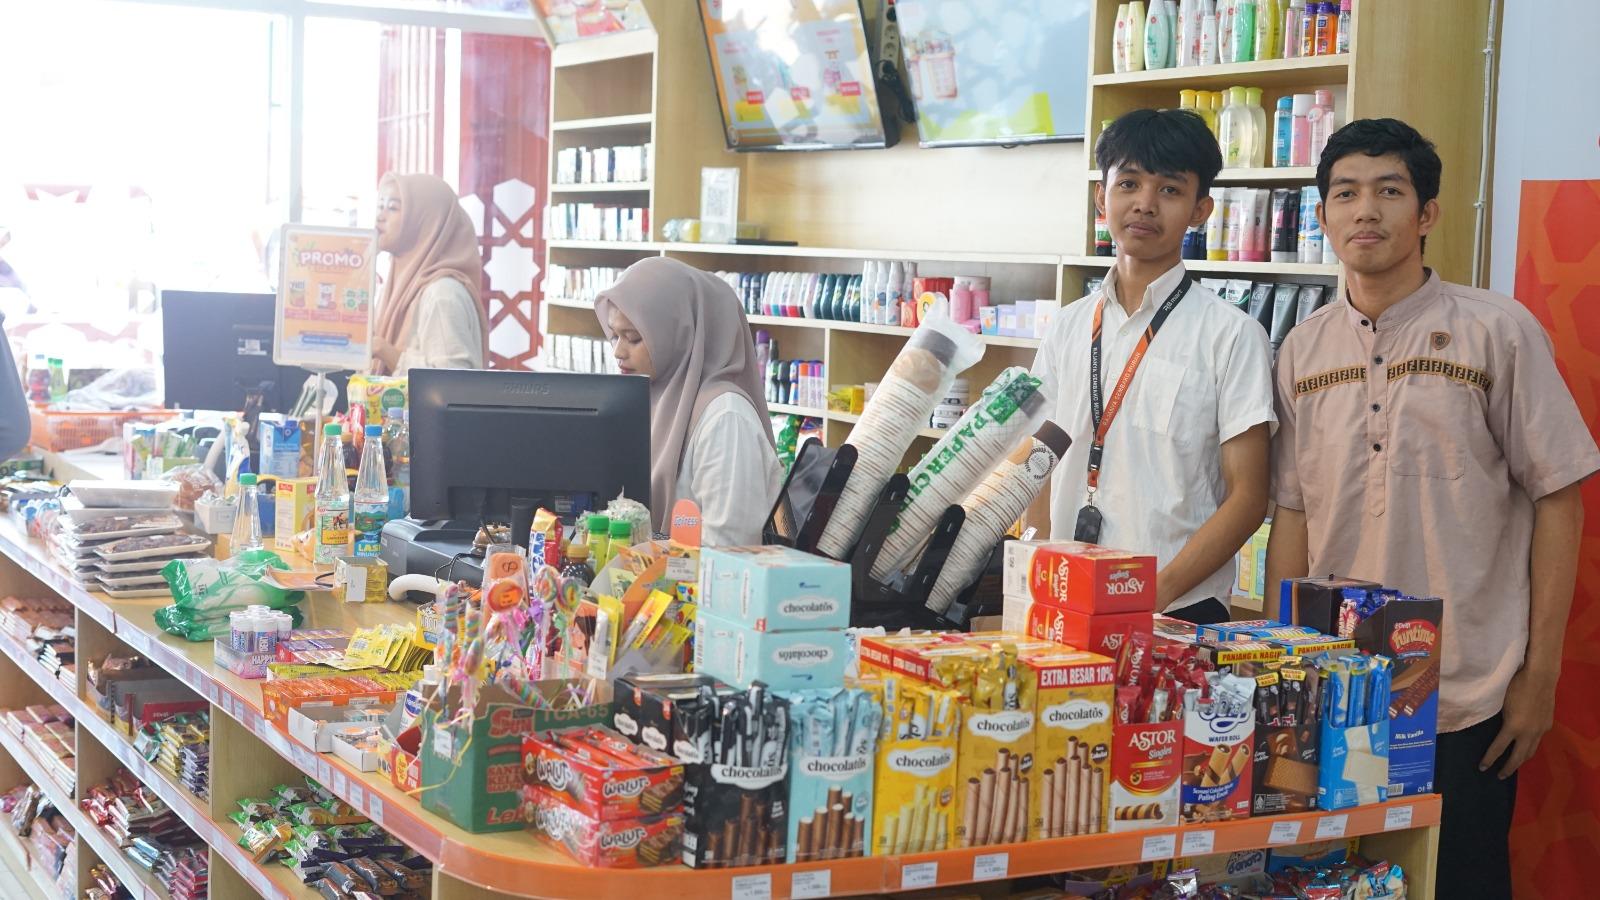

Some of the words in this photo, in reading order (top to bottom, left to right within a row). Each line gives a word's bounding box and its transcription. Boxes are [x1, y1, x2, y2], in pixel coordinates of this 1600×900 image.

[300, 251, 363, 268] PROMO
[504, 383, 551, 395] PHILIPS
[925, 410, 990, 476] PAPER
[1058, 556, 1070, 603] ASTOR
[1106, 577, 1145, 596] ASTOR
[1101, 633, 1125, 650] AST
[1222, 653, 1252, 661] PANJANG
[1041, 668, 1068, 686] EXTRA
[1069, 667, 1095, 684] BESAR
[1096, 665, 1114, 681] 10%
[1128, 730, 1176, 751] ASTOR
[1209, 734, 1228, 743] WAFER
[1229, 734, 1241, 742] ROLL
[1148, 745, 1173, 760] Singles
[603, 776, 651, 798] WALUT
[601, 827, 647, 849] WALUT
